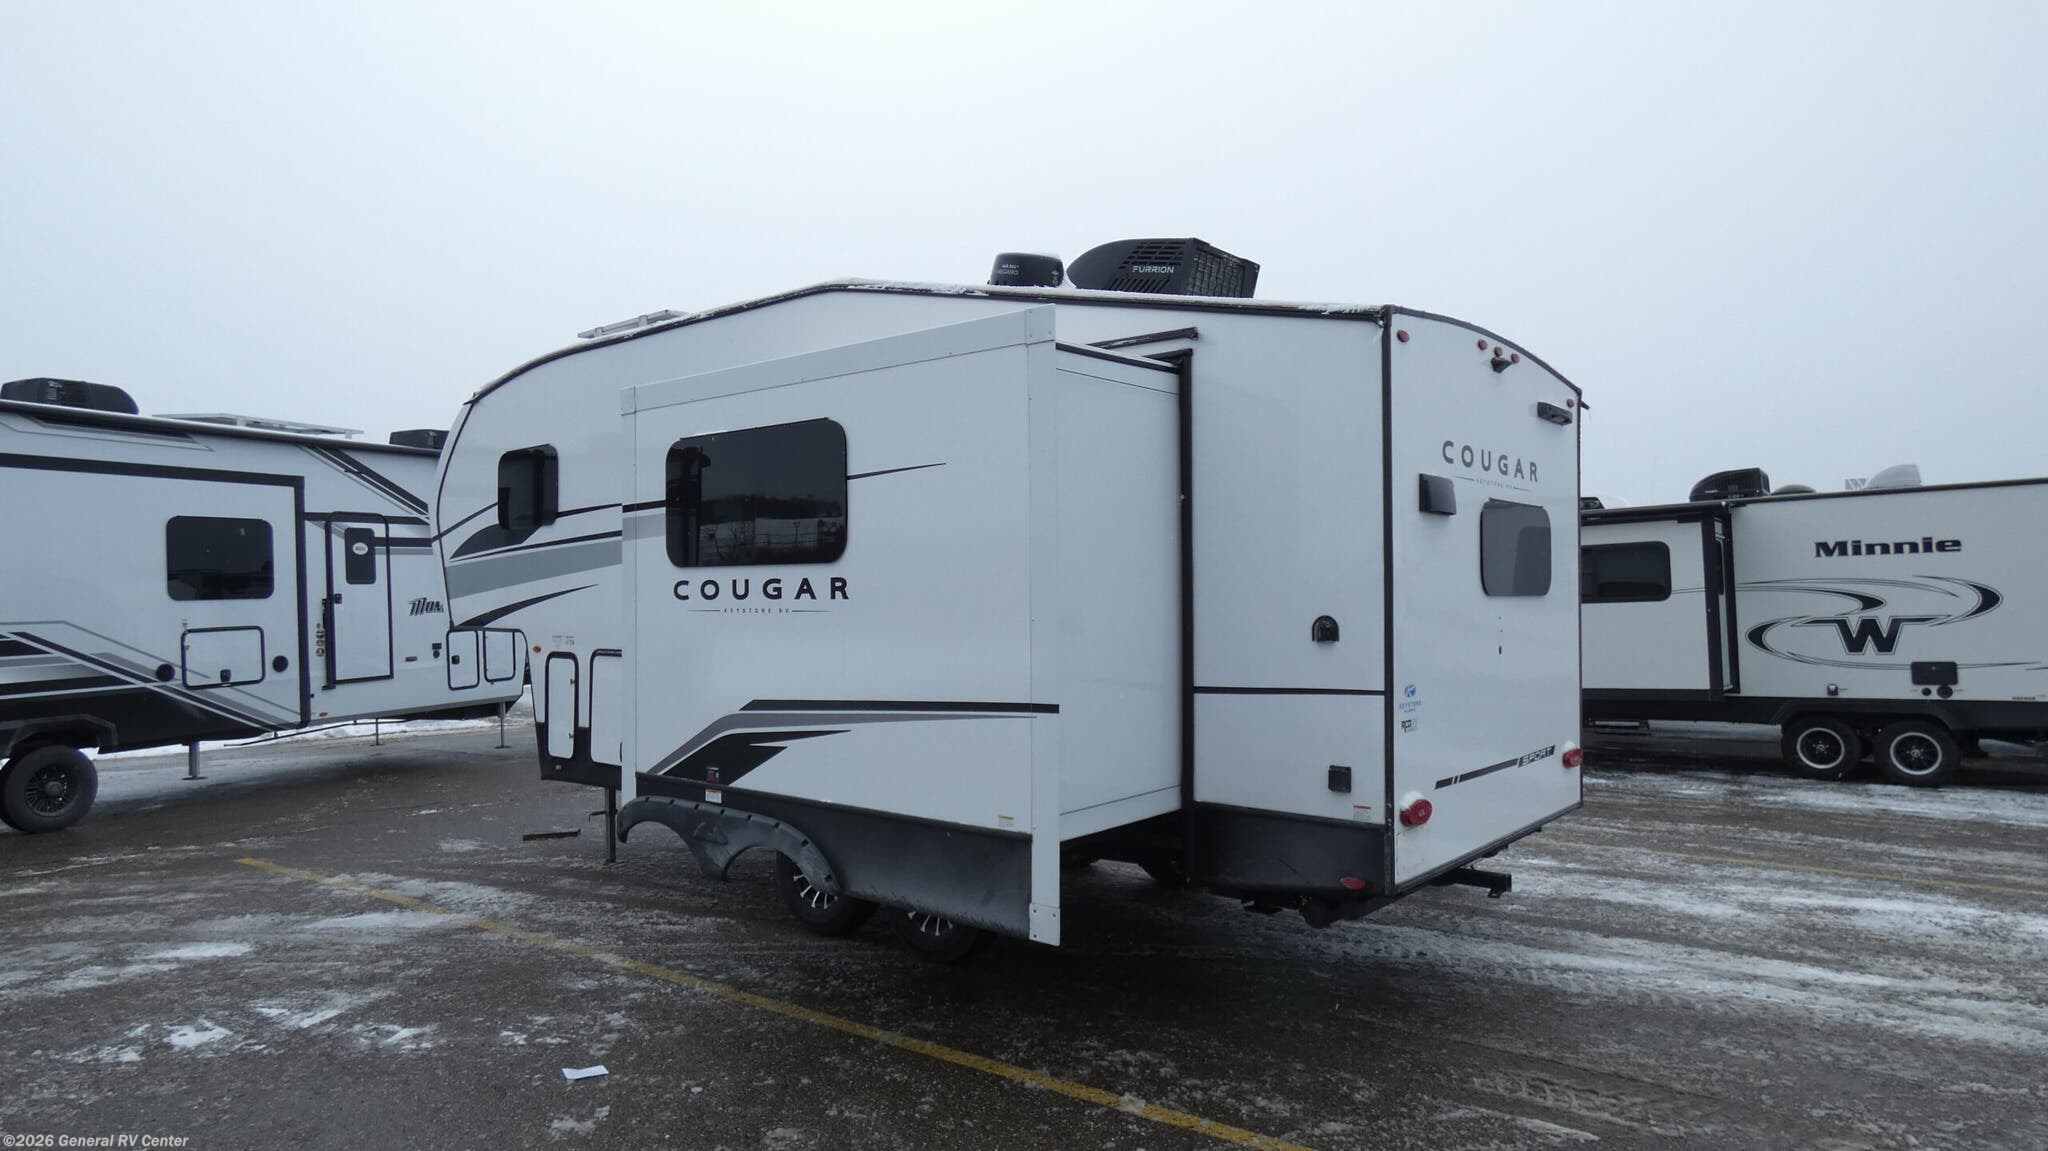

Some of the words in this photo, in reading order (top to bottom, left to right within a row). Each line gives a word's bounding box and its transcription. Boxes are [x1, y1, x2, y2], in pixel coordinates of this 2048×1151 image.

[1132, 265, 1175, 275] FURRION
[1442, 440, 1538, 483] COUGAR
[1814, 536, 1962, 559] Minnie
[673, 577, 849, 601] COUGAR
[1521, 747, 1552, 766] SPORT
